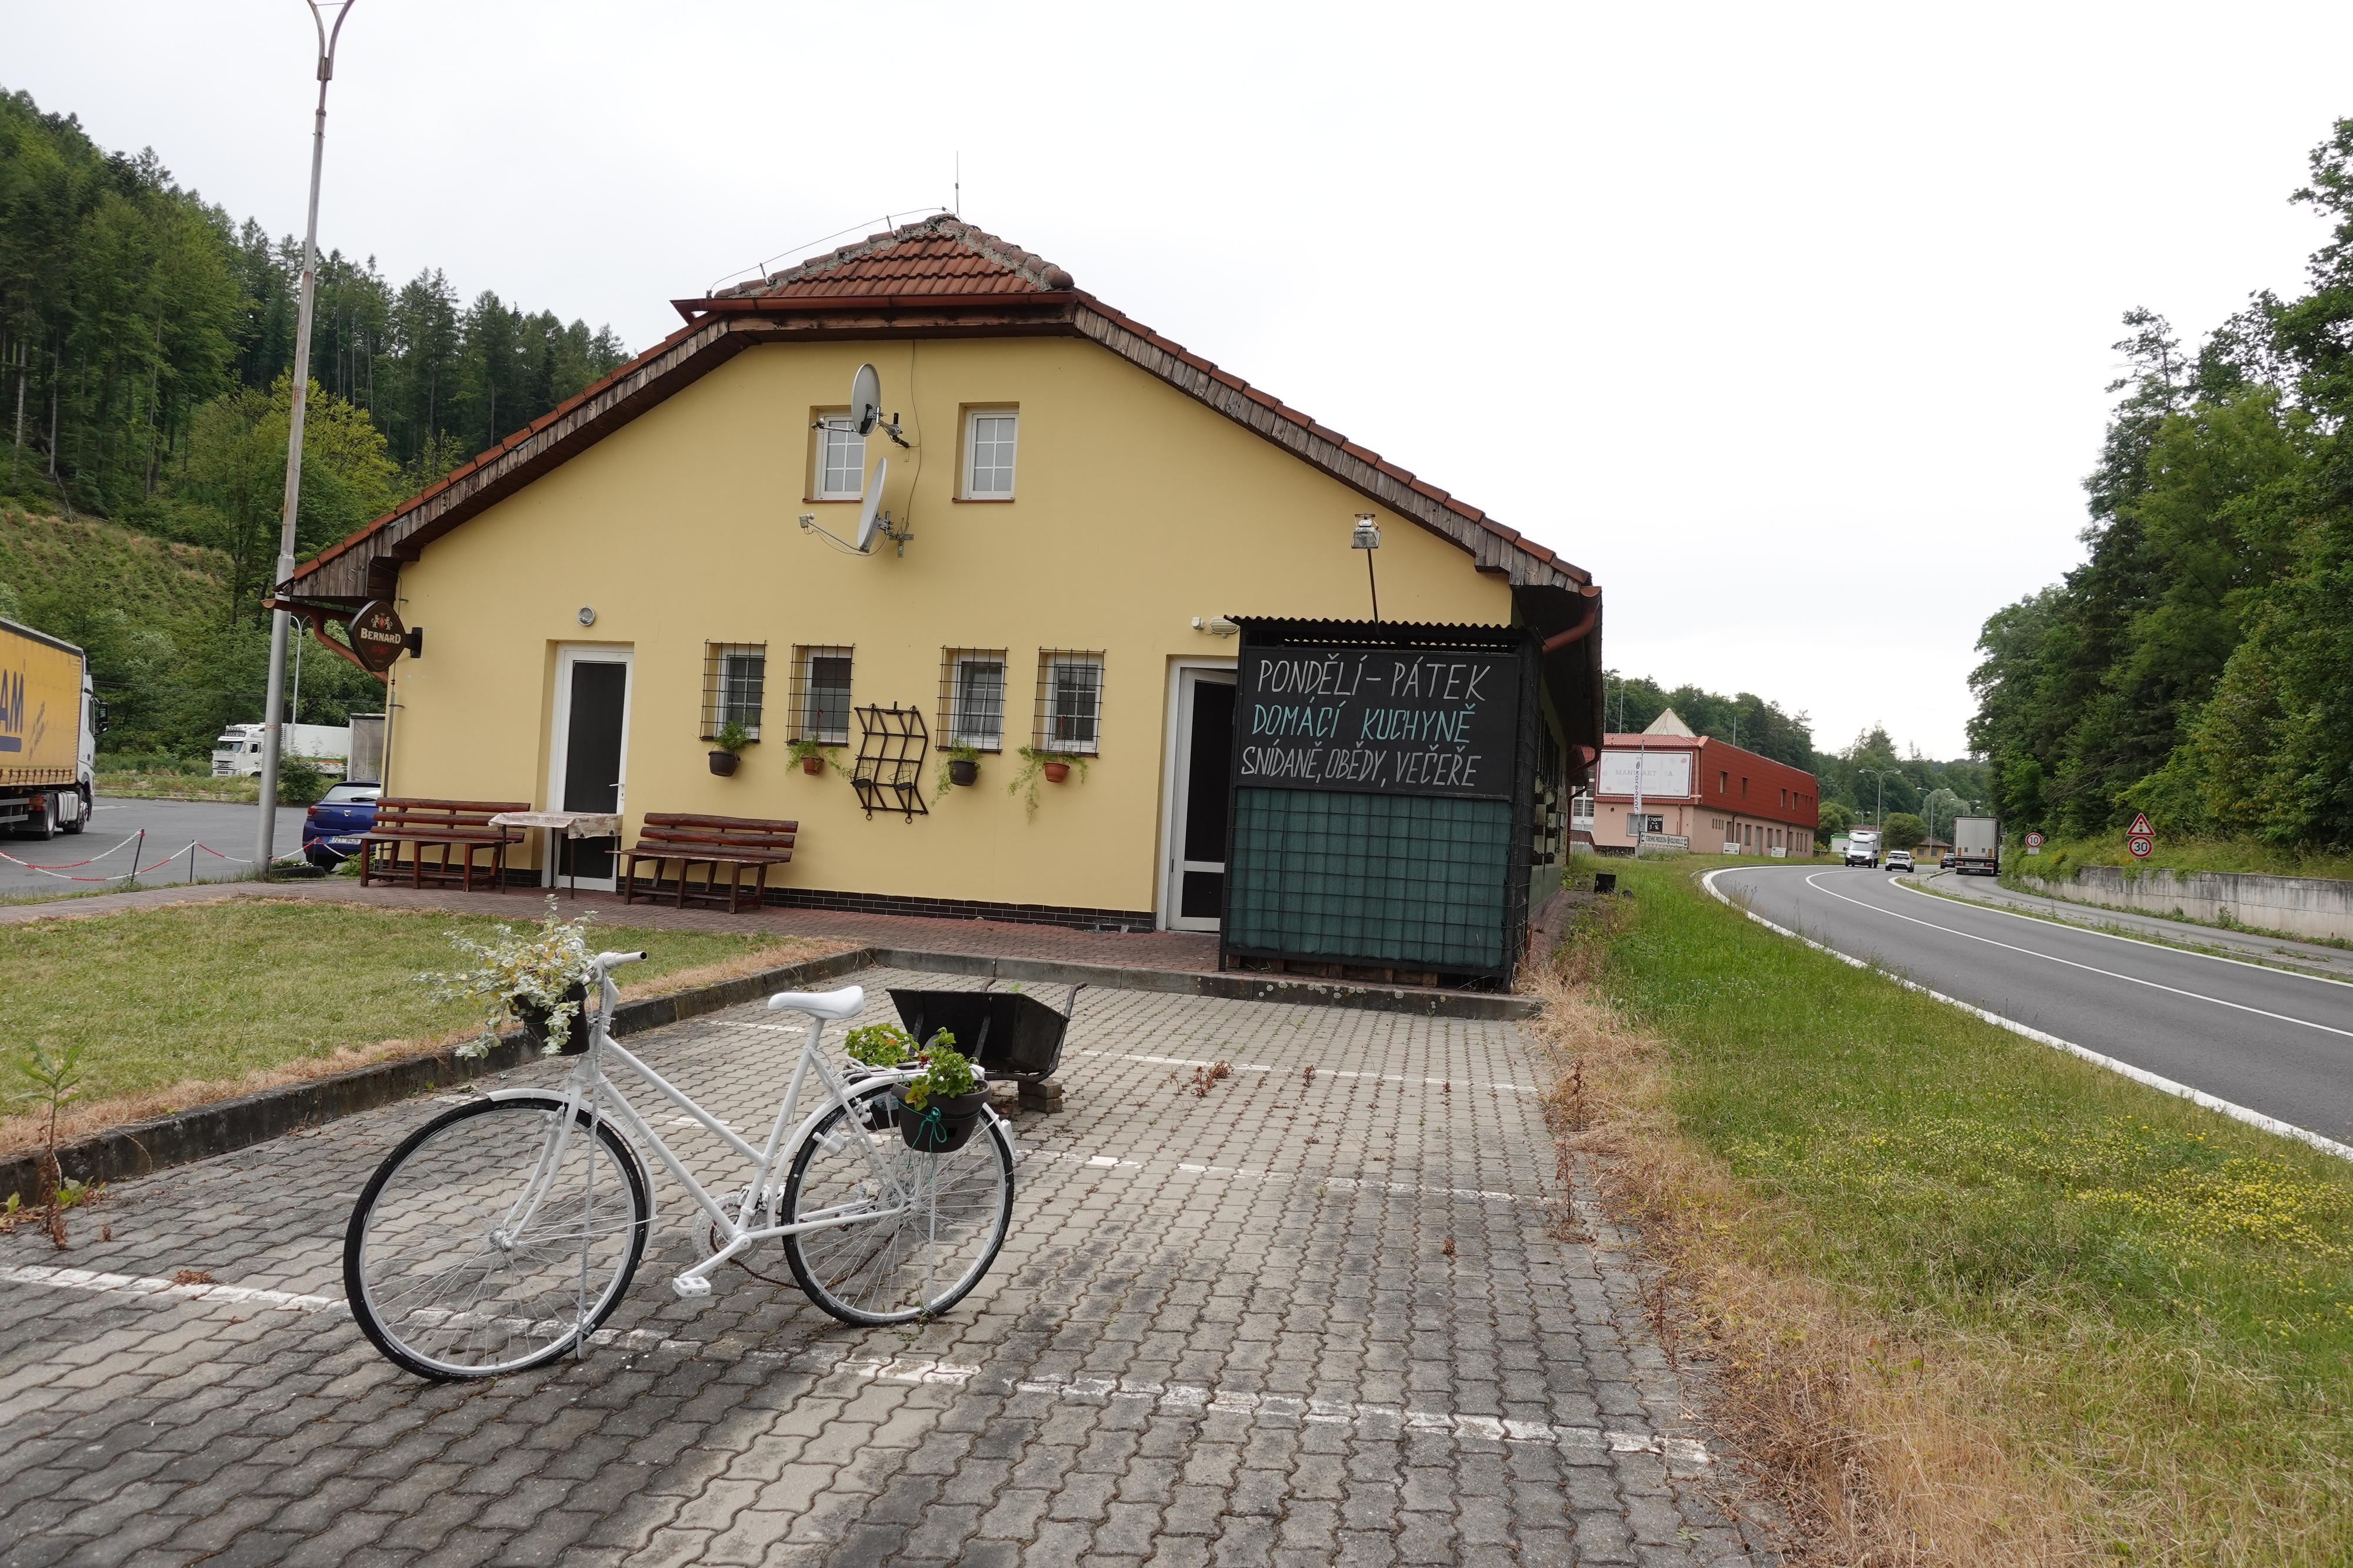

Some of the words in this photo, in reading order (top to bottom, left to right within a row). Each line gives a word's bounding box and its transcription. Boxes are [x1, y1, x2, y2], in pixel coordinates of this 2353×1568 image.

[361, 628, 401, 644] BERNARD
[1258, 653, 1368, 696] PONDĚLÍ
[1391, 656, 1491, 701] PÁTEK
[1252, 696, 1347, 738] DOMÁCÍ
[1360, 703, 1476, 743] KUCHYNĚ
[1241, 739, 1323, 783] SNÍDANĚ,
[1325, 740, 1387, 788] OBĚDY,
[1396, 744, 1482, 786] VEČEŘE
[2134, 842, 2148, 852] 30
